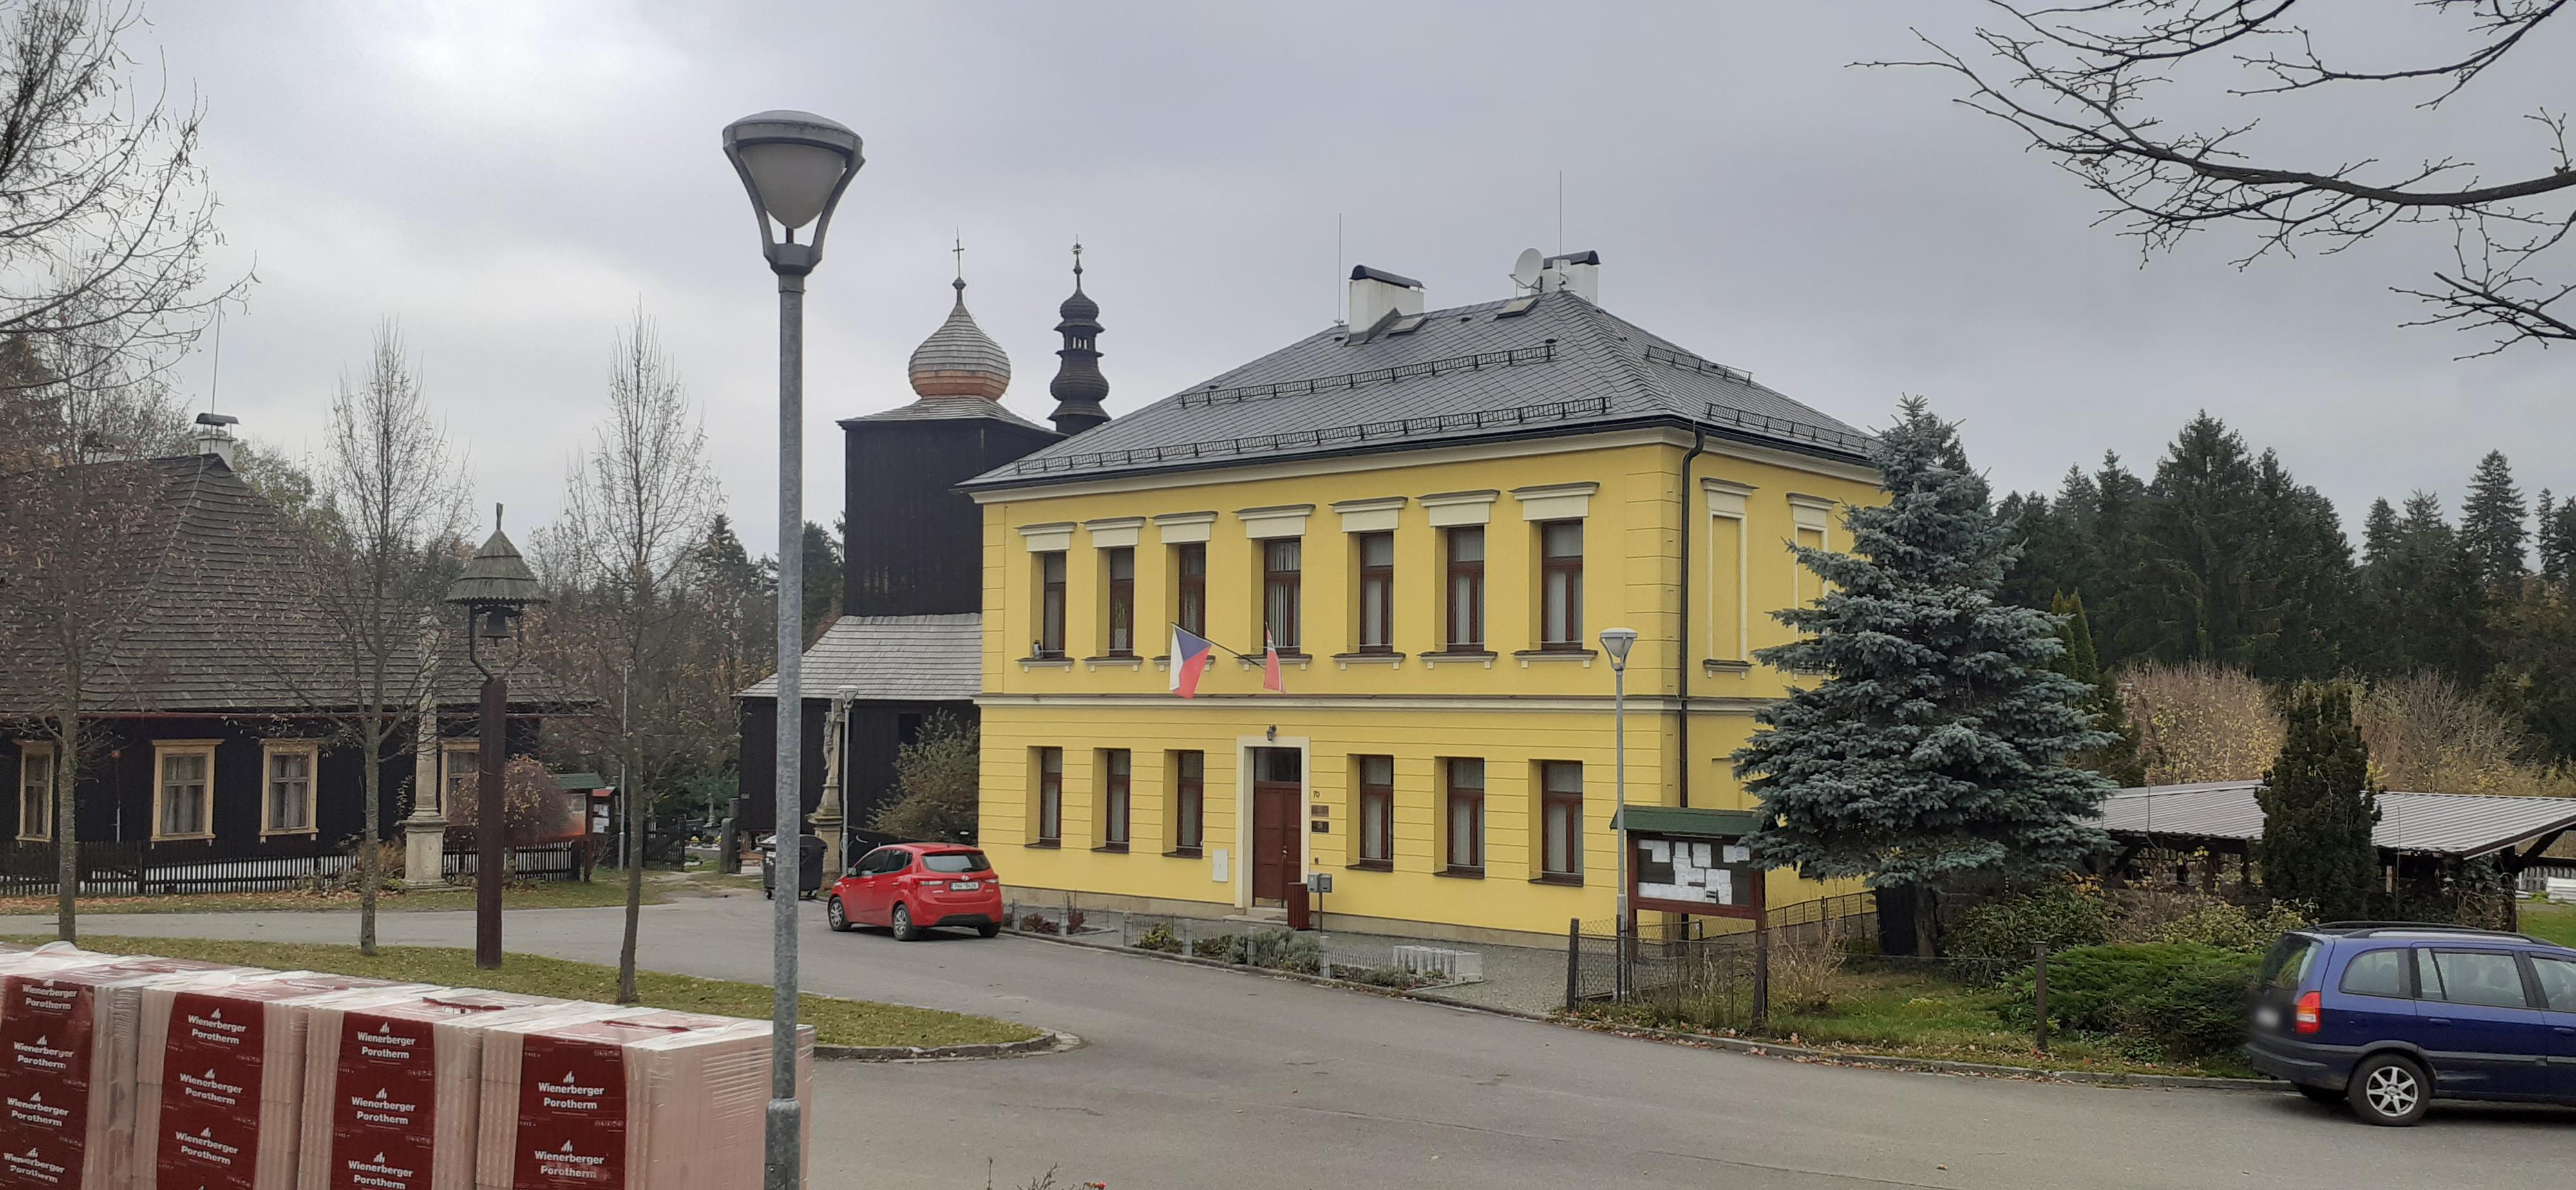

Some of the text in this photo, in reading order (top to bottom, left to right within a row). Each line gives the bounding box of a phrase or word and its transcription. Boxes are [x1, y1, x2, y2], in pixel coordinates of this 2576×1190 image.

[1313, 790, 1320, 798] 70
[22, 983, 78, 998] Wienerberger
[26, 997, 71, 1010] Porotherm
[187, 1014, 247, 1032] Wienerberger
[191, 1028, 240, 1044] Porotherm
[357, 1031, 415, 1046] Wienerberger
[14, 1041, 74, 1057] Wienerberger
[361, 1046, 410, 1059] Porotherm
[17, 1054, 66, 1069] Porotherm
[180, 1073, 243, 1093] Wienerberger
[538, 1082, 604, 1096] Wienerberger
[185, 1087, 236, 1105] Porotherm
[351, 1096, 415, 1112] Wienerberger
[544, 1097, 598, 1110] Porotherm
[6, 1097, 69, 1116] Wienerberger
[12, 1110, 62, 1127] Porotherm
[357, 1111, 409, 1125] Porotherm
[175, 1131, 239, 1154] Wienerberger
[3, 1152, 65, 1173] Wienerberger
[181, 1145, 231, 1166] Porotherm
[535, 1150, 604, 1165] Wienerberger
[10, 1164, 58, 1184] Porotherm
[348, 1160, 413, 1177] Wienerberger
[540, 1165, 596, 1178] Porotherm
[354, 1175, 406, 1189] Porotherm
